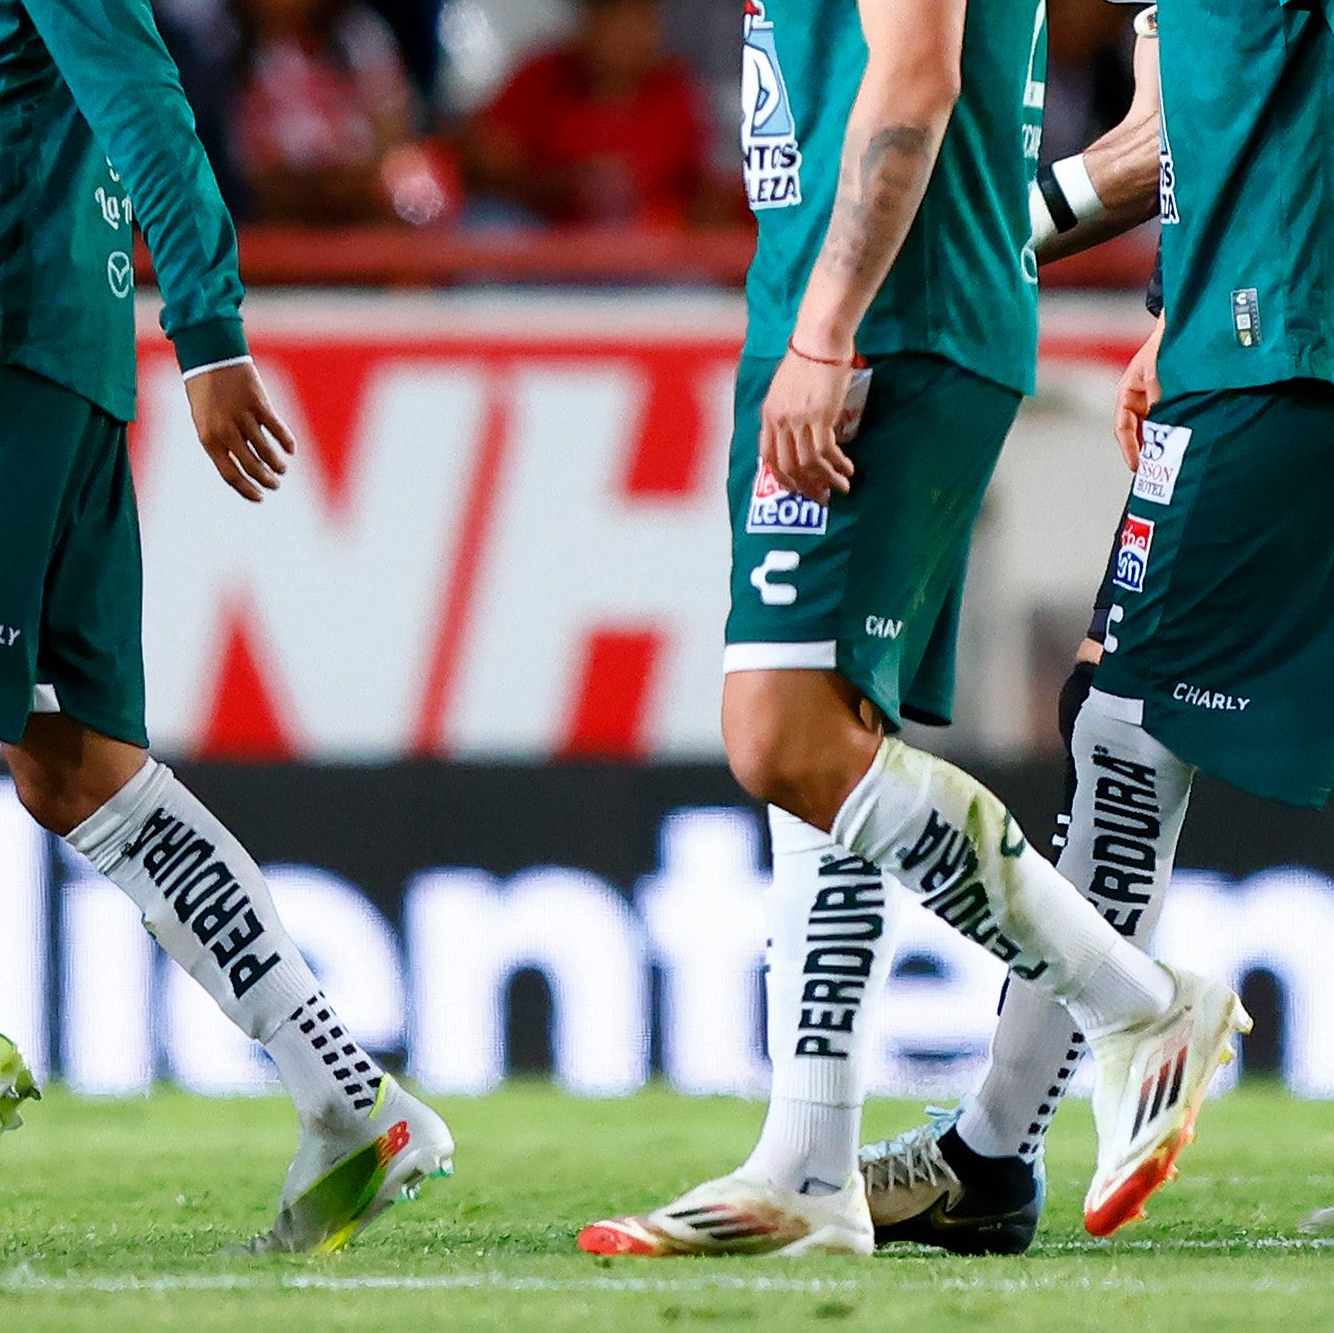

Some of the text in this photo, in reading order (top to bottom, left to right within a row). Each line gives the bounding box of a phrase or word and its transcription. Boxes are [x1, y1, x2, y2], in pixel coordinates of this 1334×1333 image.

[1172, 682, 1251, 712] CHARLY
[129, 806, 281, 1000] PERDURA
[1088, 750, 1163, 937] ERDURA
[795, 852, 886, 1059] PERDURA
